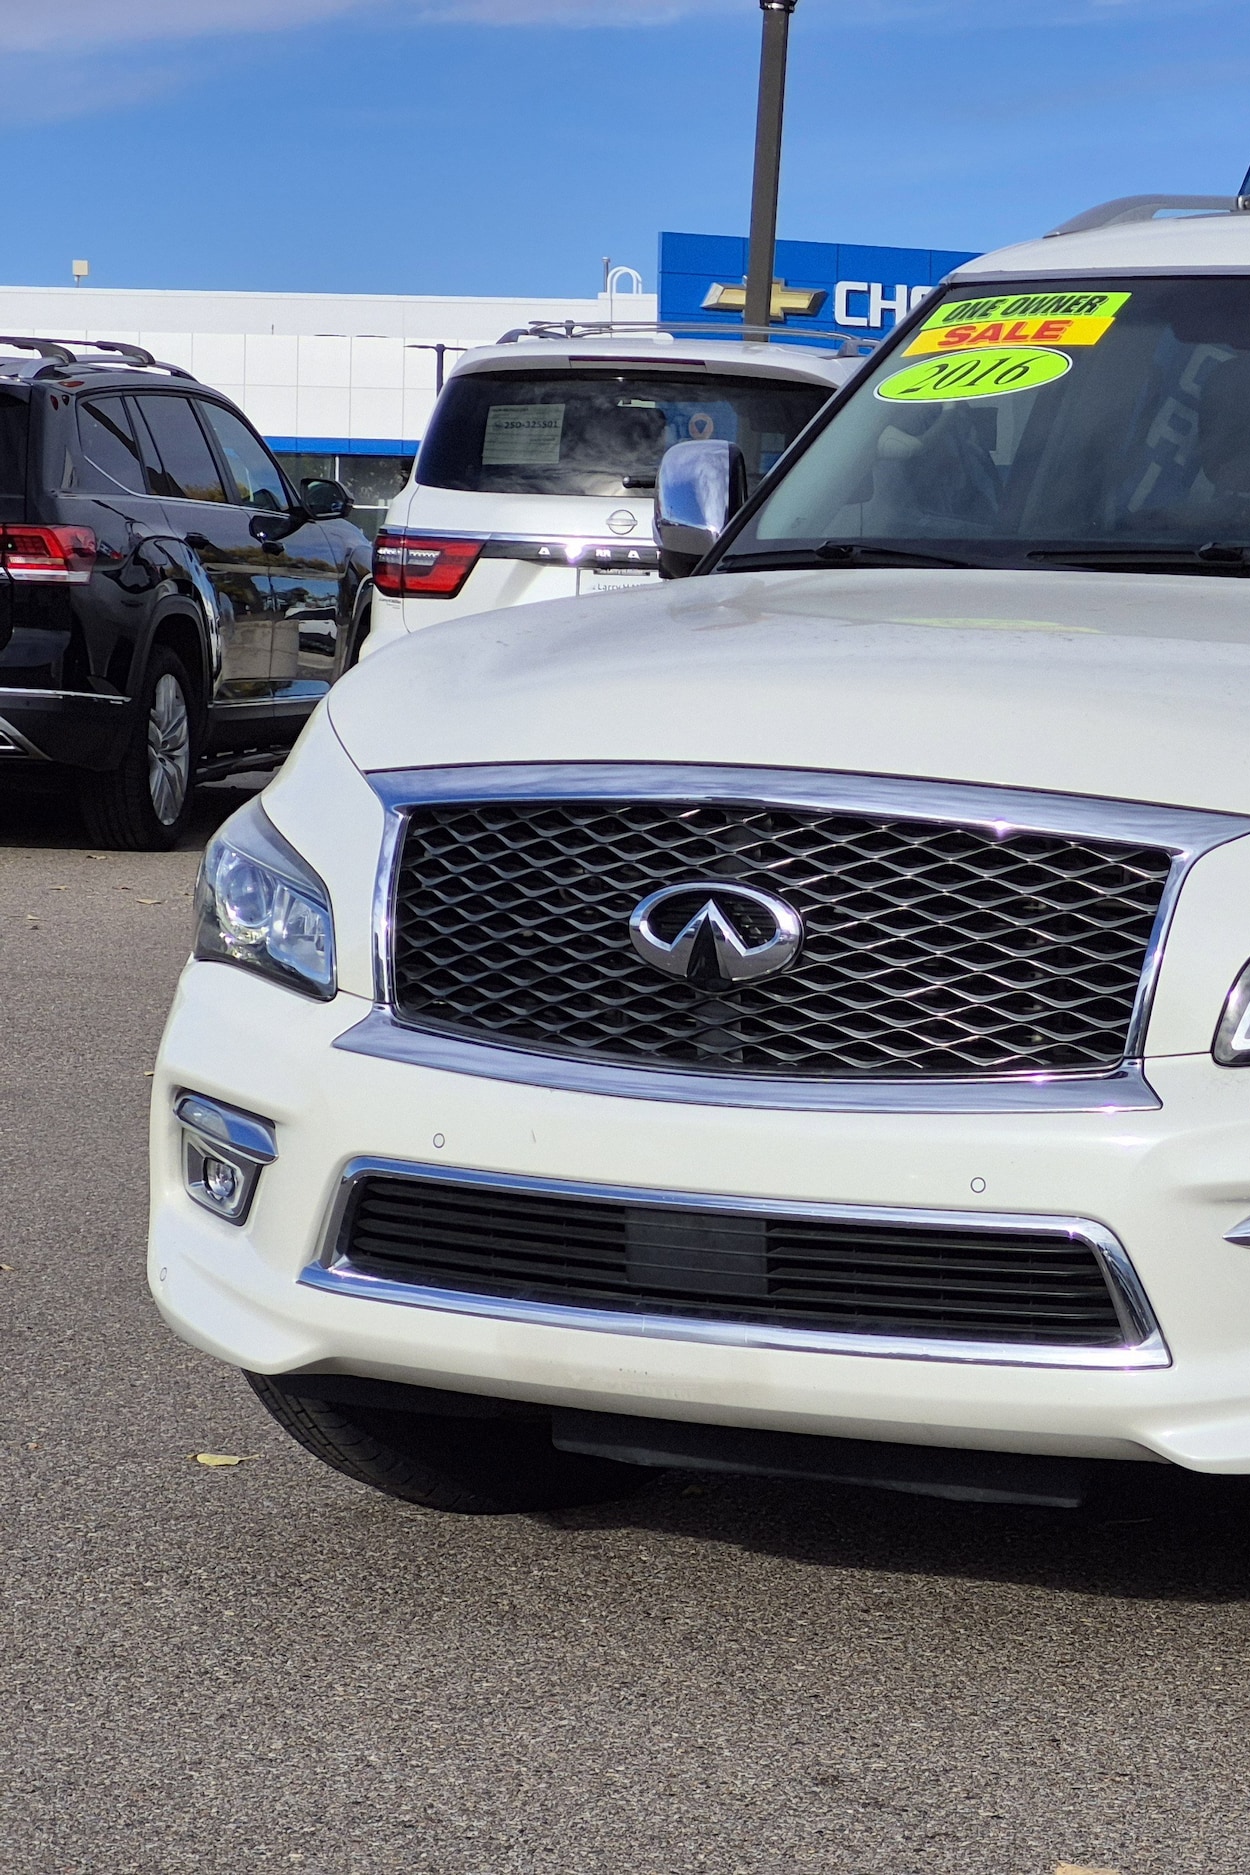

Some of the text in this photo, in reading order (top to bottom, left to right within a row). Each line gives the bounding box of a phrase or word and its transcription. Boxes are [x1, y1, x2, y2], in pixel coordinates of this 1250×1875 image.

[941, 294, 1109, 323] ONE OWNER
[937, 319, 1072, 347] SALE
[897, 353, 1050, 395] 2016
